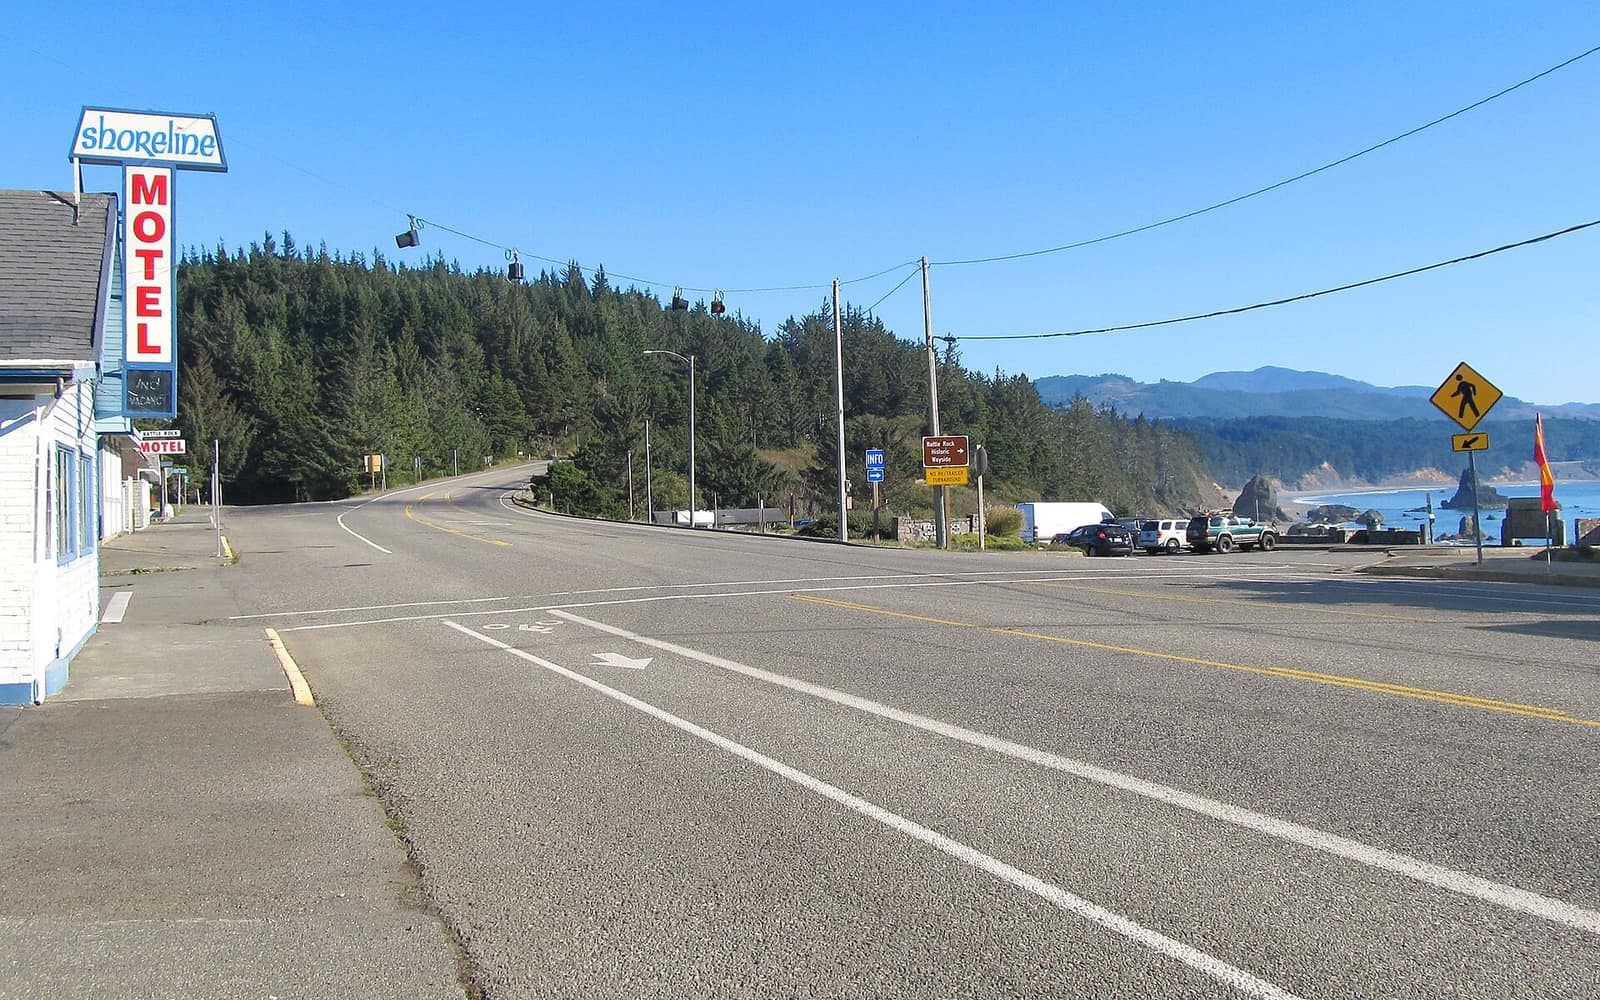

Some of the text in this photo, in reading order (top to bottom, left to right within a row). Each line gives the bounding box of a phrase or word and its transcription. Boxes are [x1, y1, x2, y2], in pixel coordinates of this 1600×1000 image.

[81, 115, 216, 157] shoreline
[131, 173, 168, 355] MOTEL
[127, 395, 167, 406] VACANC
[140, 441, 184, 453] MOTEL
[931, 447, 950, 455] Historic
[867, 453, 884, 465] INFO
[931, 456, 952, 464] Wayside
